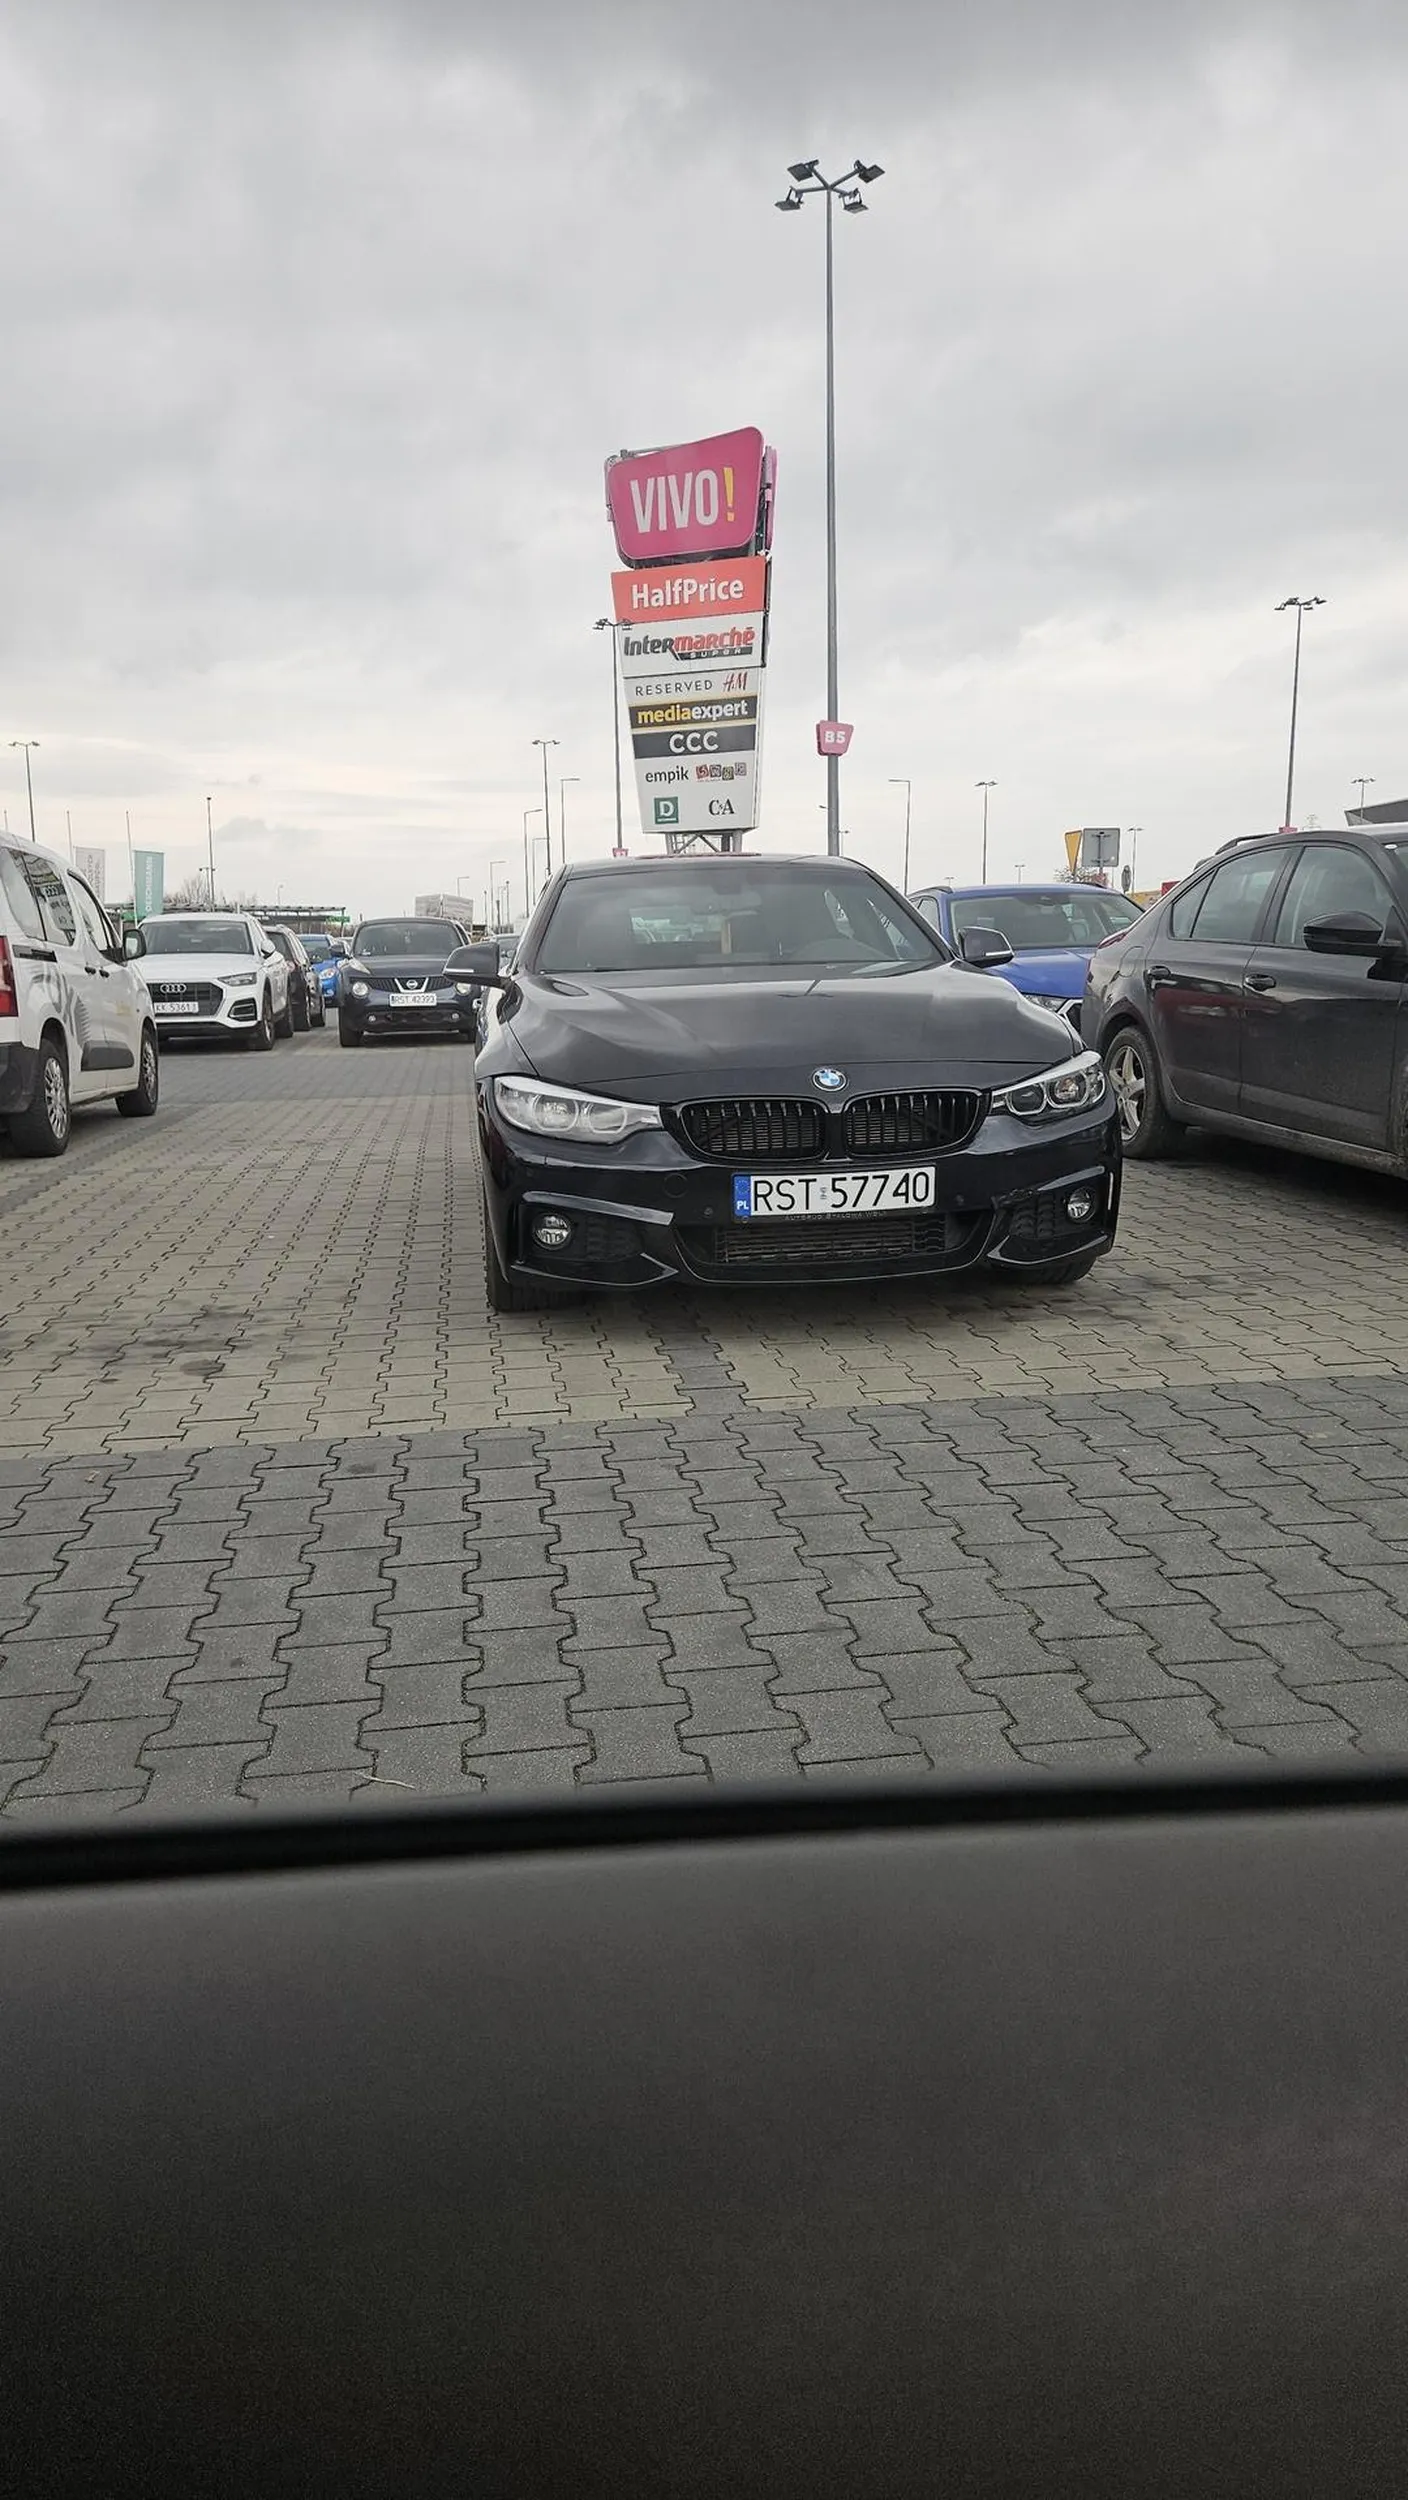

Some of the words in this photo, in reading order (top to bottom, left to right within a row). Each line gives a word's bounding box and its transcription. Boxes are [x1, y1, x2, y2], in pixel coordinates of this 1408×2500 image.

[630, 467, 735, 533] VIVO!
[631, 577, 744, 609] HalfPrice
[635, 680, 713, 696] RESERVED
[722, 672, 748, 692] H&M
[637, 700, 748, 723] mediaexpert
[669, 731, 719, 753] CCC
[825, 730, 846, 744] B5
[645, 765, 689, 784] empik
[708, 798, 735, 816] C&A
[753, 1178, 817, 1212] RST
[830, 1172, 930, 1208] 57740
[736, 1201, 749, 1210] PL
